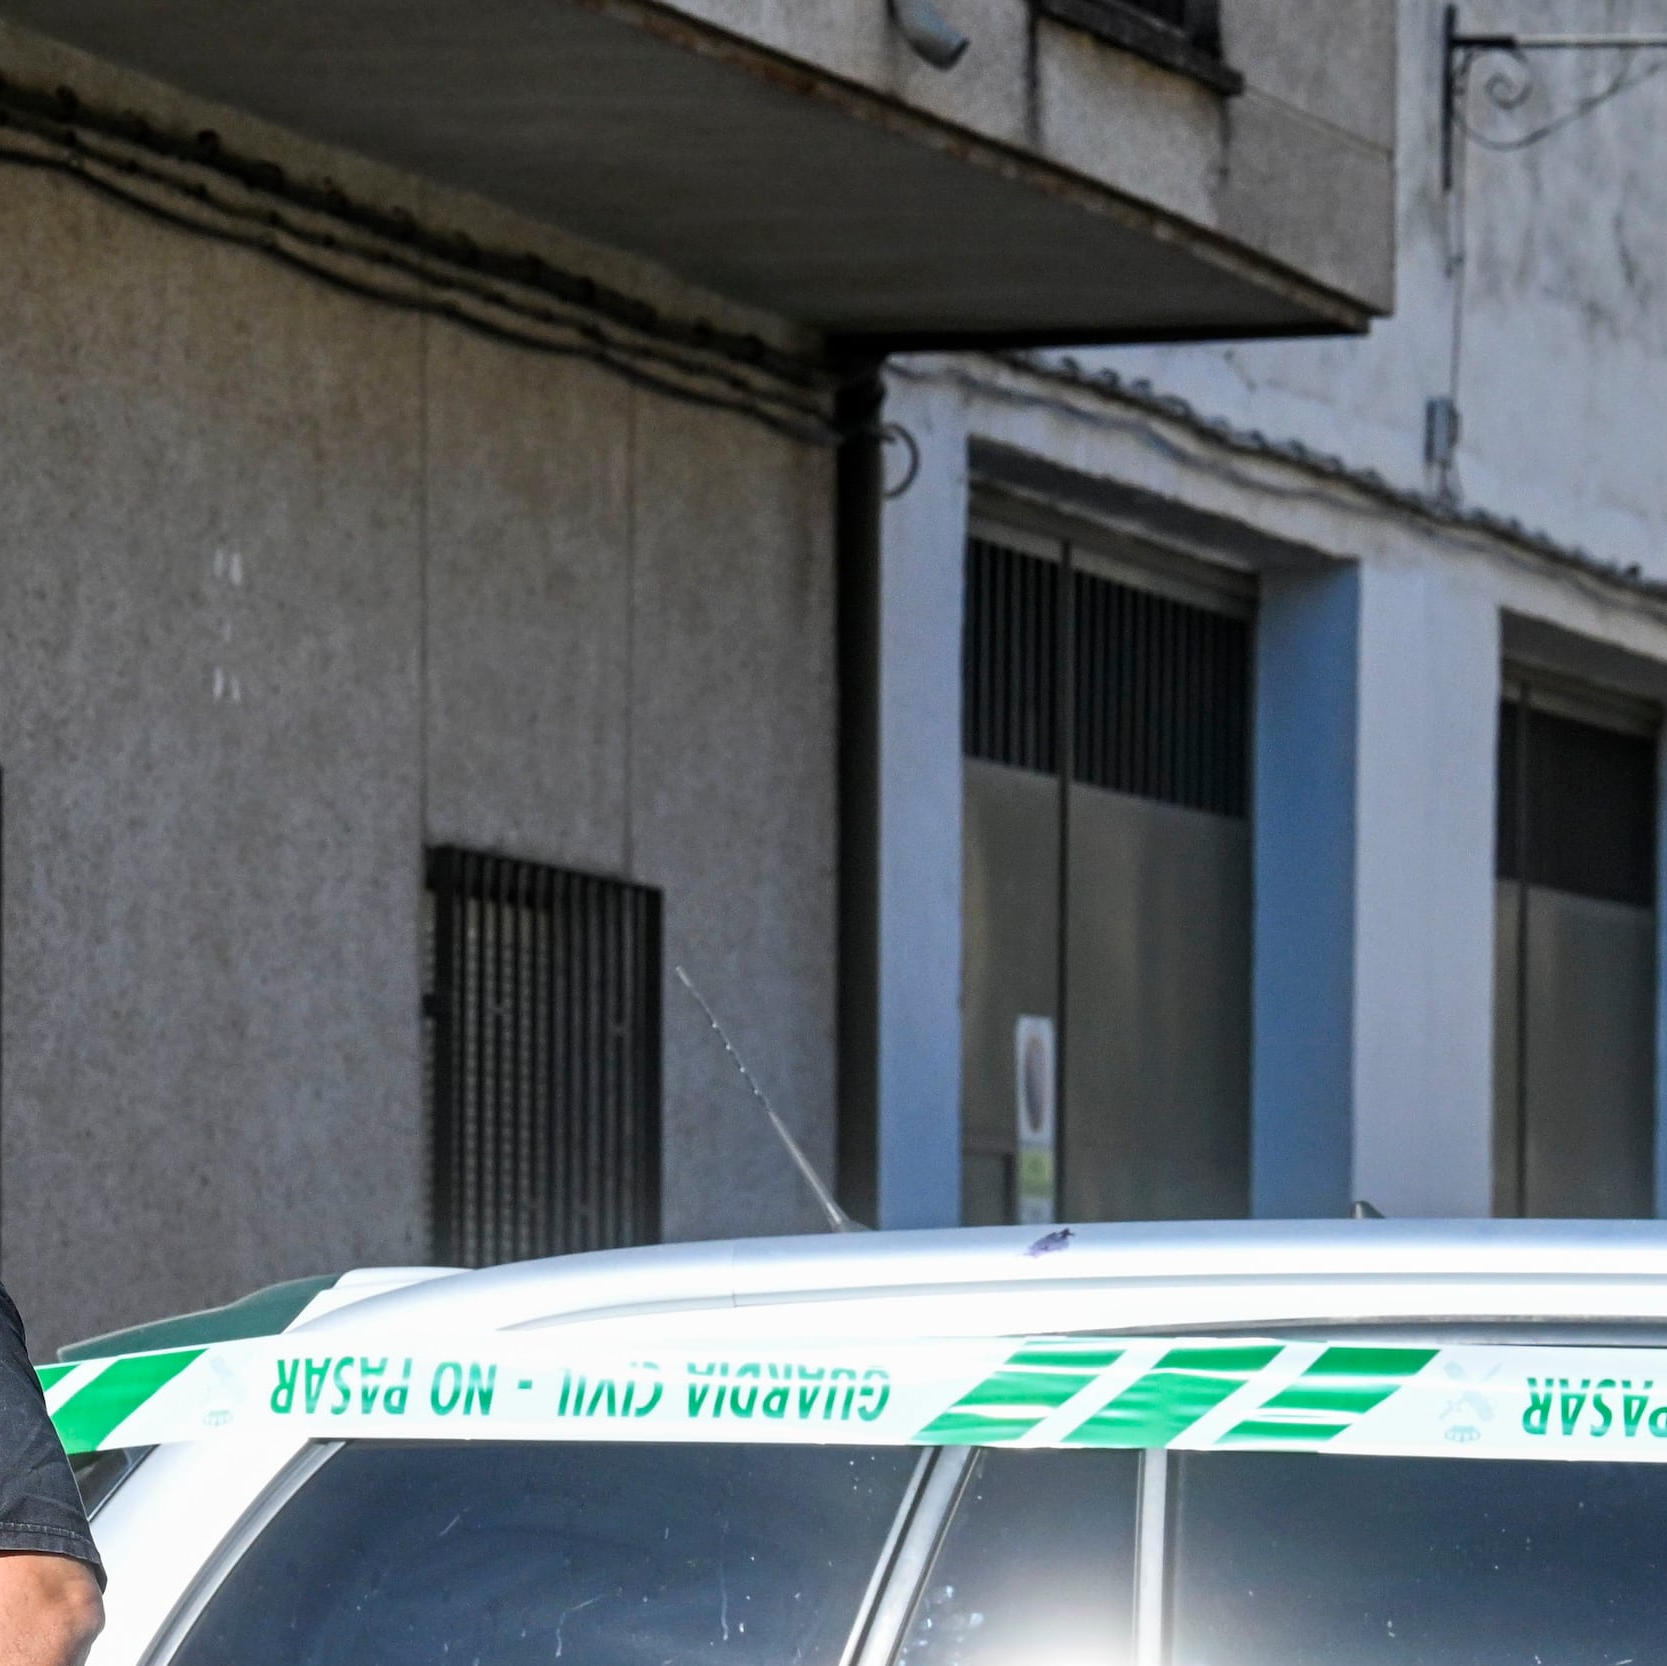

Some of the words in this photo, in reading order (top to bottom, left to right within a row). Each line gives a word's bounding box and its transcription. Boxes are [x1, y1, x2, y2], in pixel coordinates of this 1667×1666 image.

[269, 1356, 413, 1415] PASAR
[429, 1361, 497, 1416] NO
[686, 1361, 892, 1422] GUARDIA
